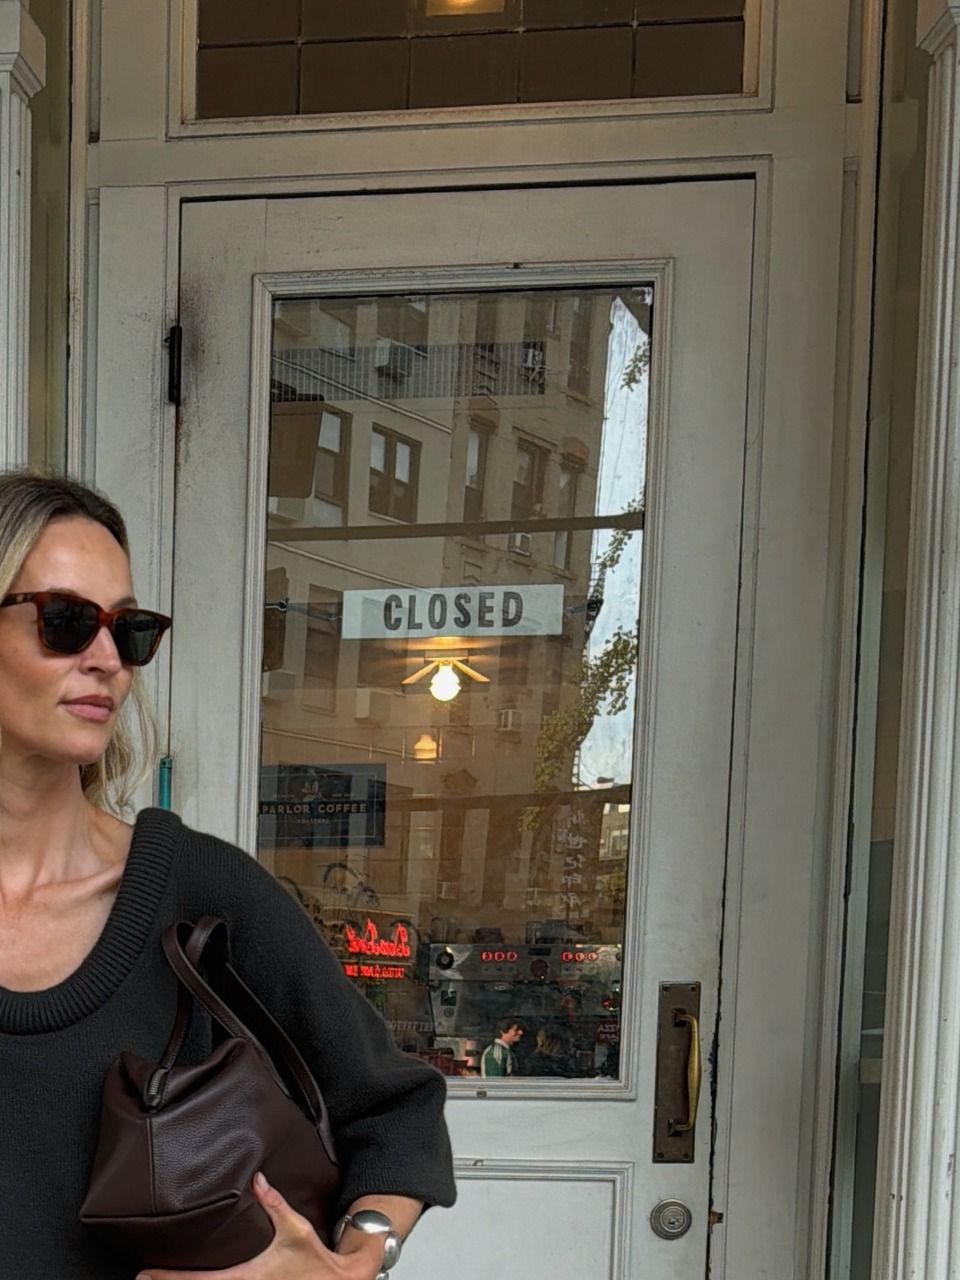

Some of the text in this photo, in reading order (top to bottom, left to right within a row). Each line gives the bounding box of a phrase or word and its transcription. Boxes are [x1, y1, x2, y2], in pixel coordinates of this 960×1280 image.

[383, 591, 524, 631] CLOSED
[262, 803, 367, 814] PARLOR COFFEE
